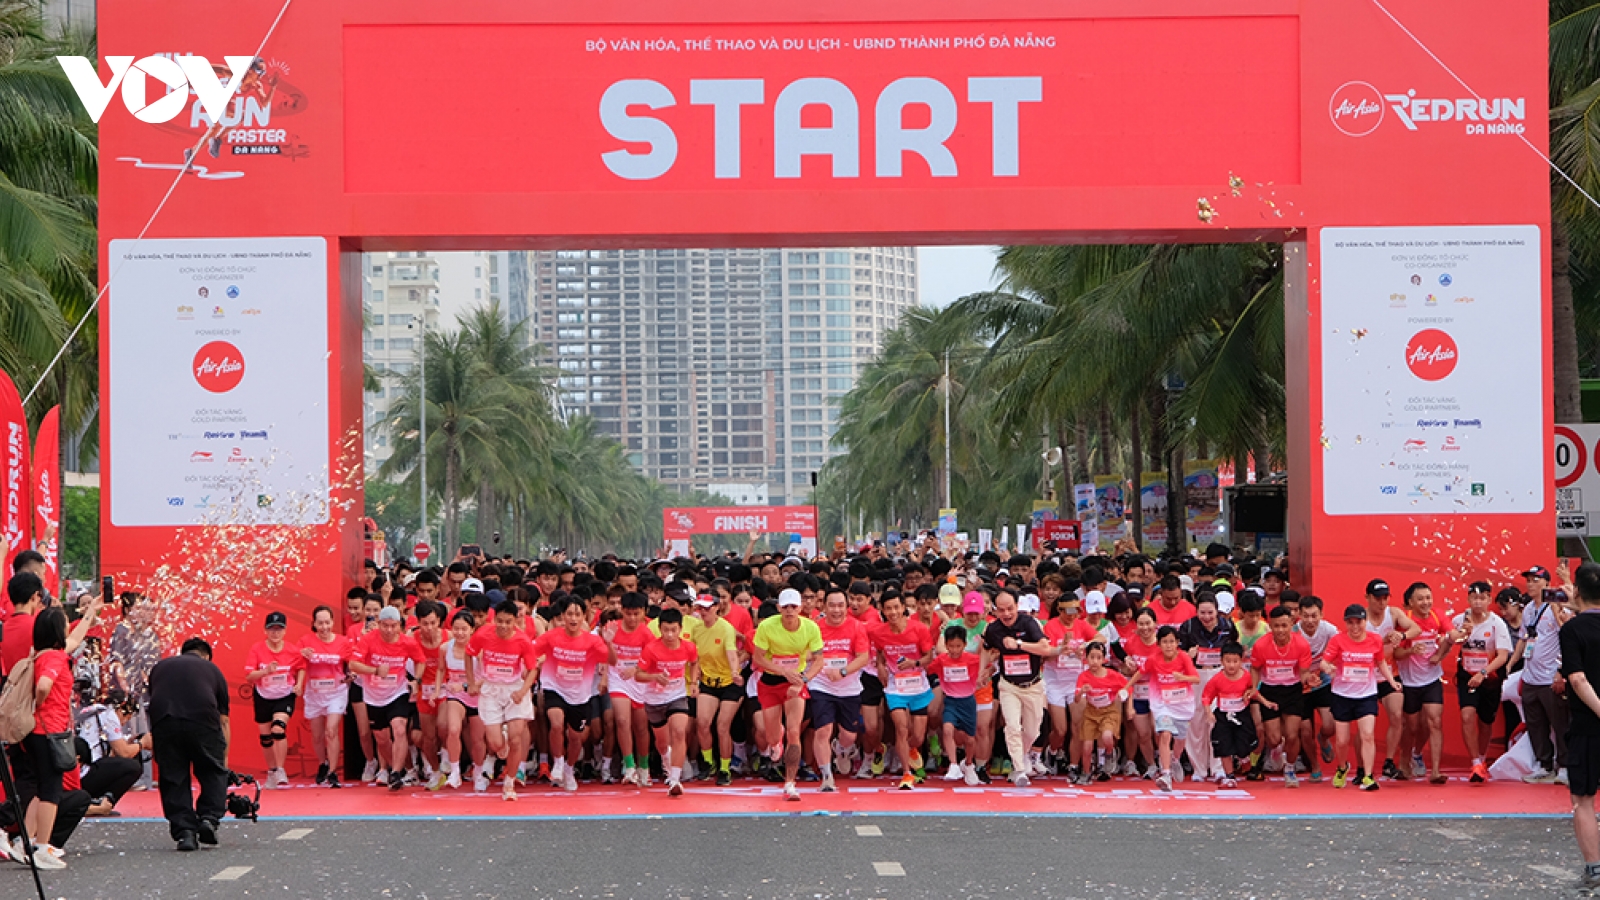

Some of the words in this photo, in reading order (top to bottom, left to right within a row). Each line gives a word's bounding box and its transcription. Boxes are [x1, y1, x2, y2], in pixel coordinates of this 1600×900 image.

[585, 37, 607, 53] BỘ
[609, 37, 640, 51] VĂN
[644, 36, 681, 52] HÓA,
[684, 35, 711, 50] THỂ
[715, 38, 756, 50] THAO
[759, 36, 779, 50] VÀ
[783, 38, 804, 50] DU
[808, 37, 841, 53] LỊCH
[853, 38, 896, 49] UBND
[899, 35, 950, 49] THÀNH
[953, 33, 985, 48] PHỐ
[988, 33, 1010, 48] ĐÀ
[1014, 32, 1057, 48] NẴNG
[1384, 89, 1526, 130] REDRUN
[227, 129, 287, 143] FASTER
[599, 76, 1043, 180] START
[1466, 124, 1484, 135] DA
[1487, 124, 1526, 135] NANG
[251, 145, 279, 154] NANG
[1555, 443, 1571, 467] 0
[714, 515, 768, 530] FINISH
